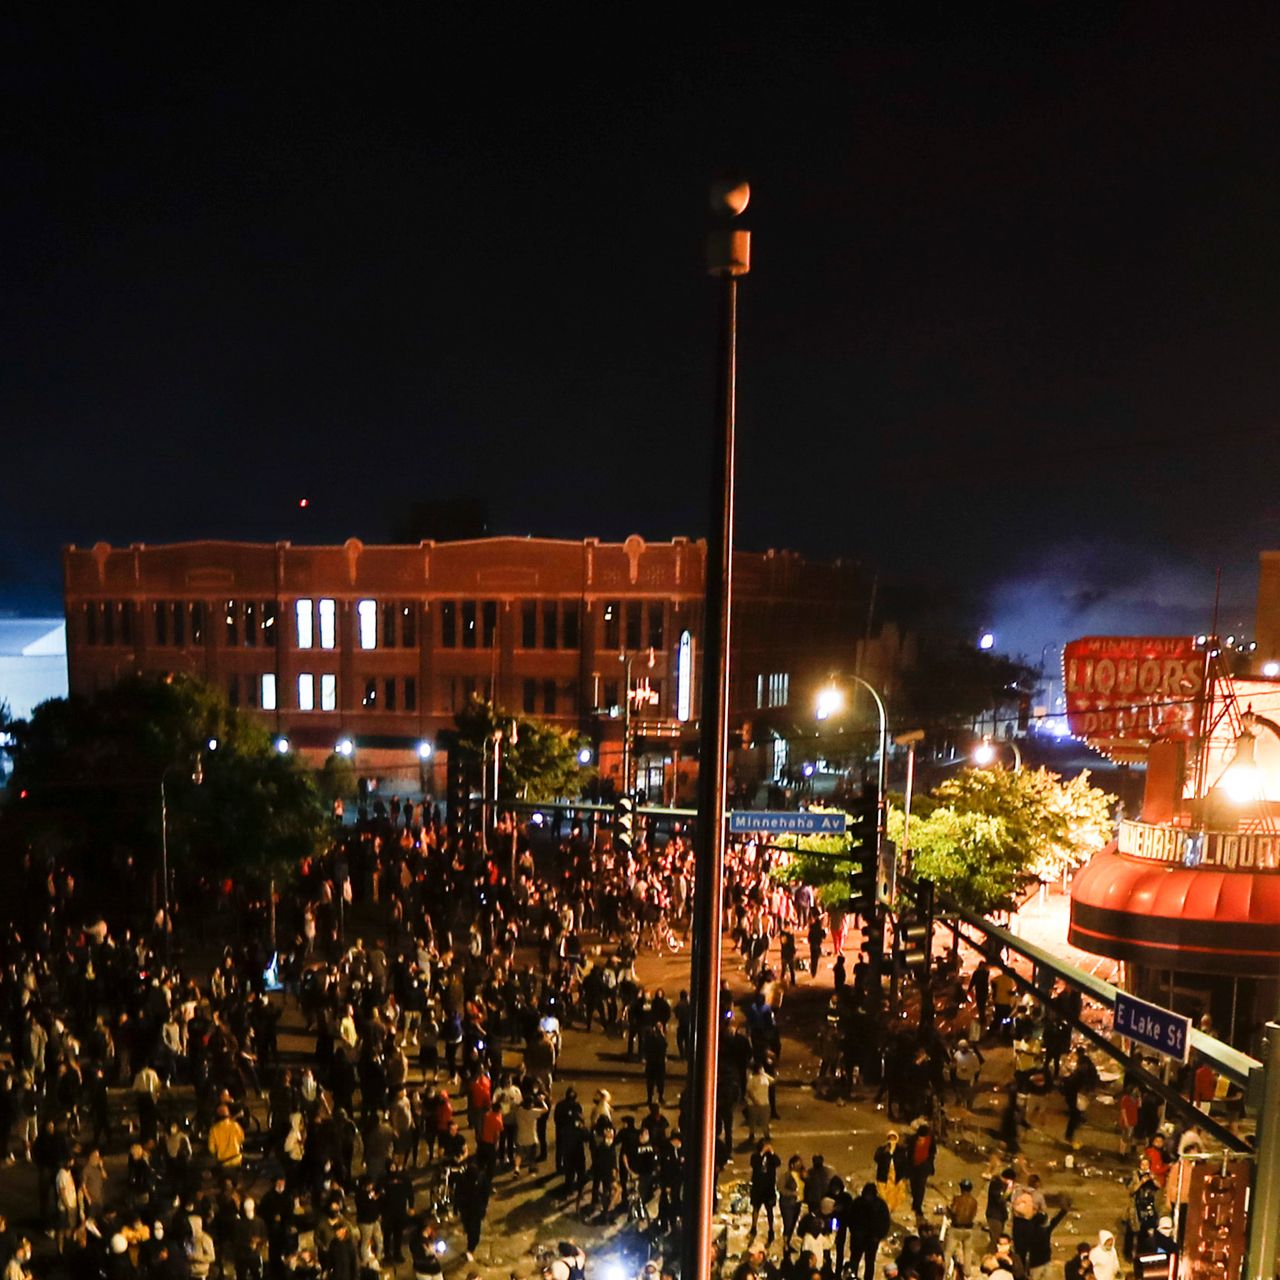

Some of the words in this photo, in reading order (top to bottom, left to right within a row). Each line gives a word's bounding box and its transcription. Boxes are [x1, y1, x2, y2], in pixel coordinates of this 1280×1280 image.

[1067, 658, 1203, 695] LIQUORS
[735, 816, 814, 829] Minnehaha
[821, 817, 840, 829] Av
[1117, 1003, 1125, 1025] E
[1130, 1009, 1161, 1040] Lake
[1166, 1024, 1182, 1049] St
